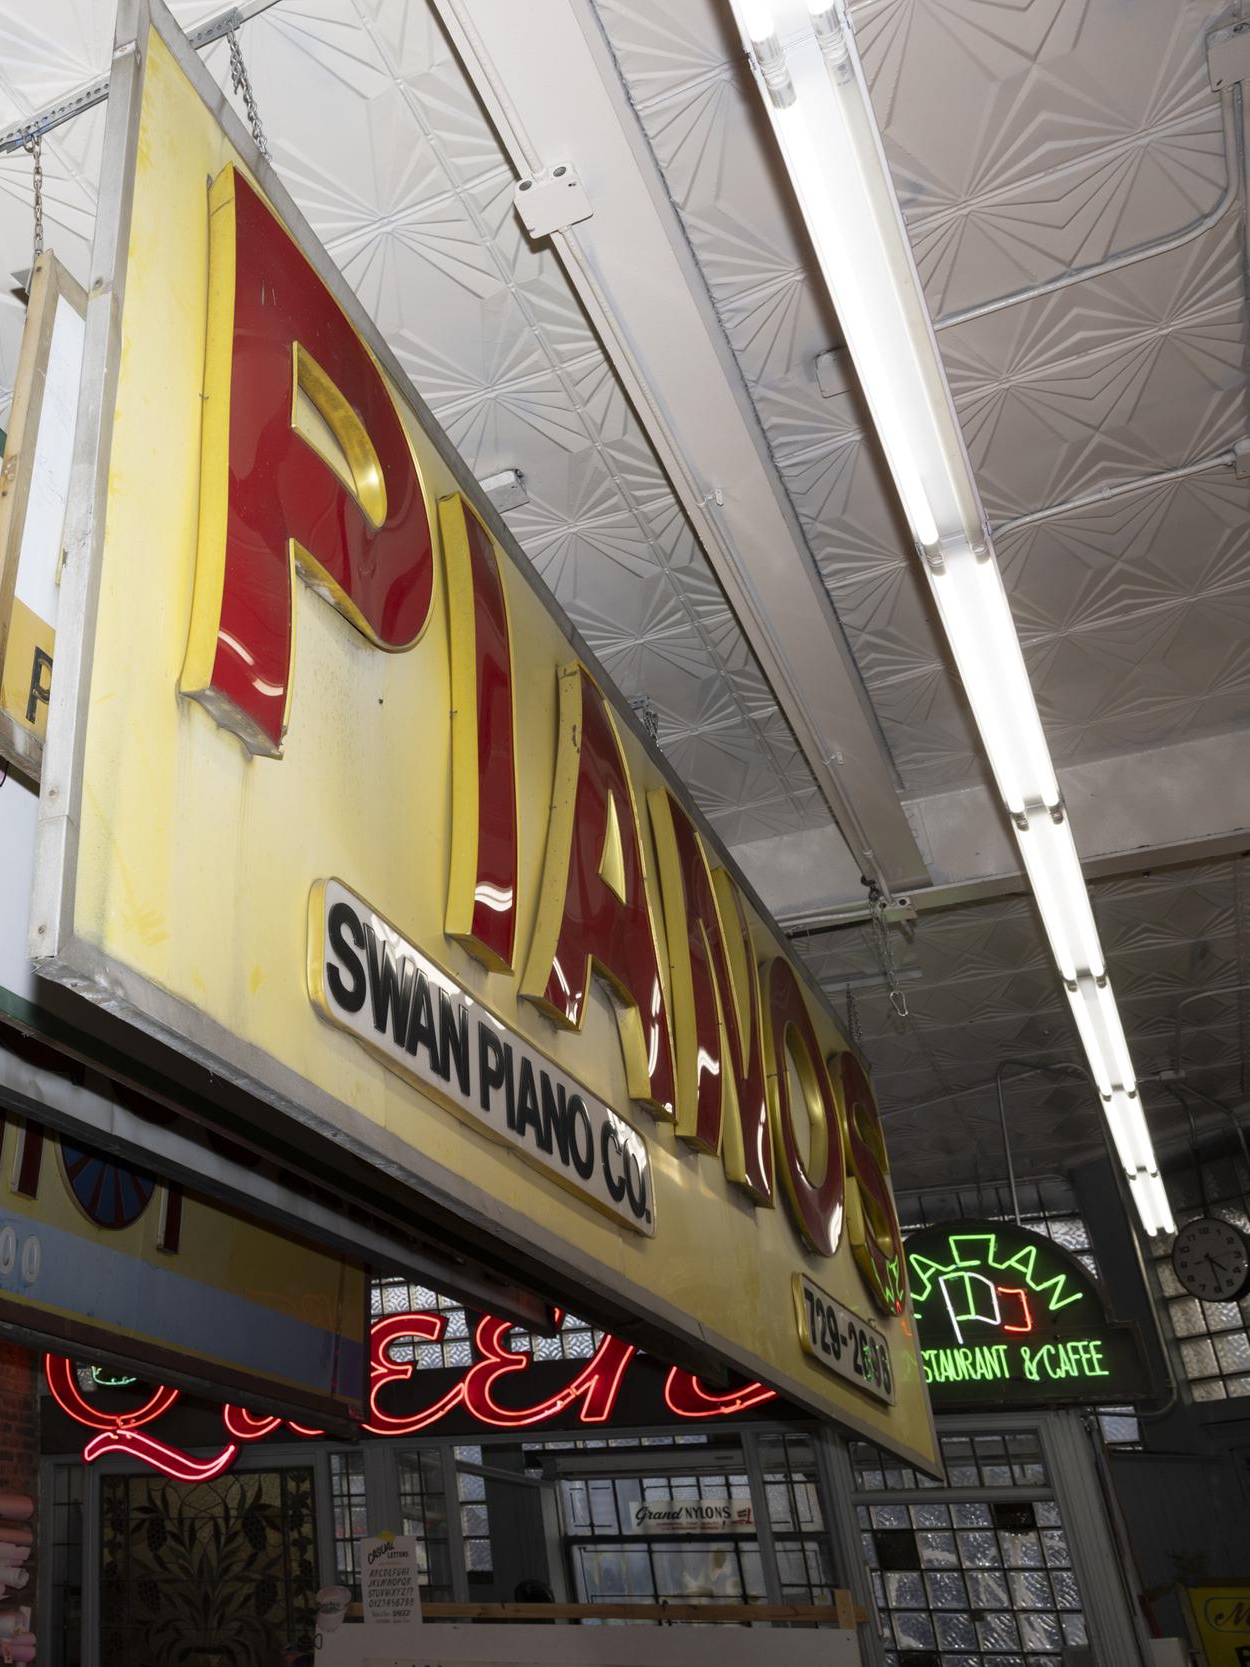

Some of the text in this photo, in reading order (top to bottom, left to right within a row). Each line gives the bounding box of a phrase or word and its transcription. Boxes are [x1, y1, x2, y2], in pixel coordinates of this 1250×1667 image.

[181, 160, 907, 1317] PIANOS
[326, 902, 652, 1225] SWAN PIANO CO.
[635, 1506, 684, 1527] Grand
[684, 1506, 732, 1519] NYLONS
